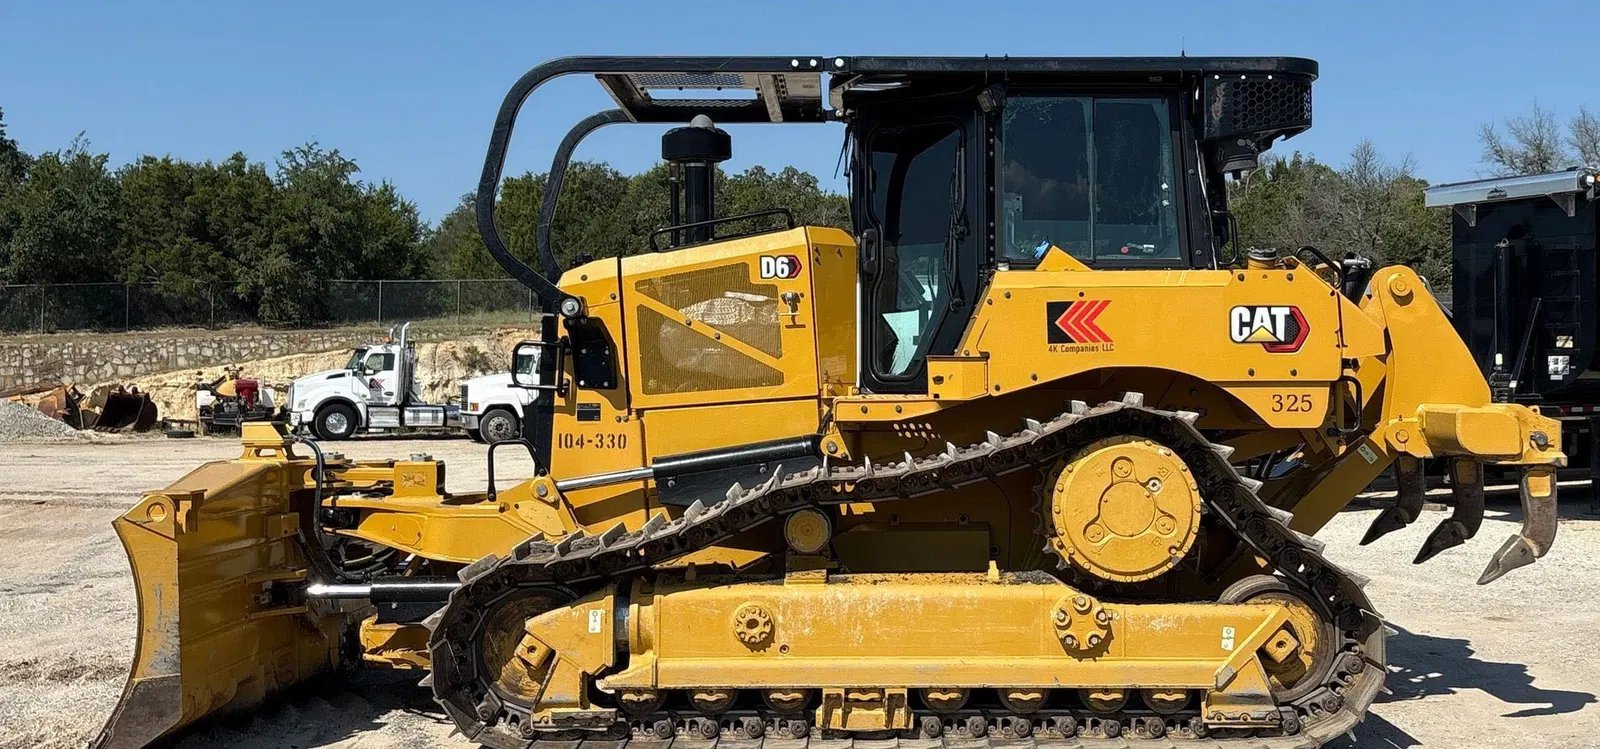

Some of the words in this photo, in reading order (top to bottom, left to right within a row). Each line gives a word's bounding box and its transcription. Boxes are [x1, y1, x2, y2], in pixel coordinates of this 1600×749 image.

[760, 256, 789, 279] D6
[1230, 306, 1290, 342] CAT
[1048, 345, 1058, 353] 4K
[1061, 345, 1099, 354] Companies
[1102, 344, 1114, 352] LLC
[1271, 394, 1313, 413] 325
[558, 433, 627, 449] 104-330
